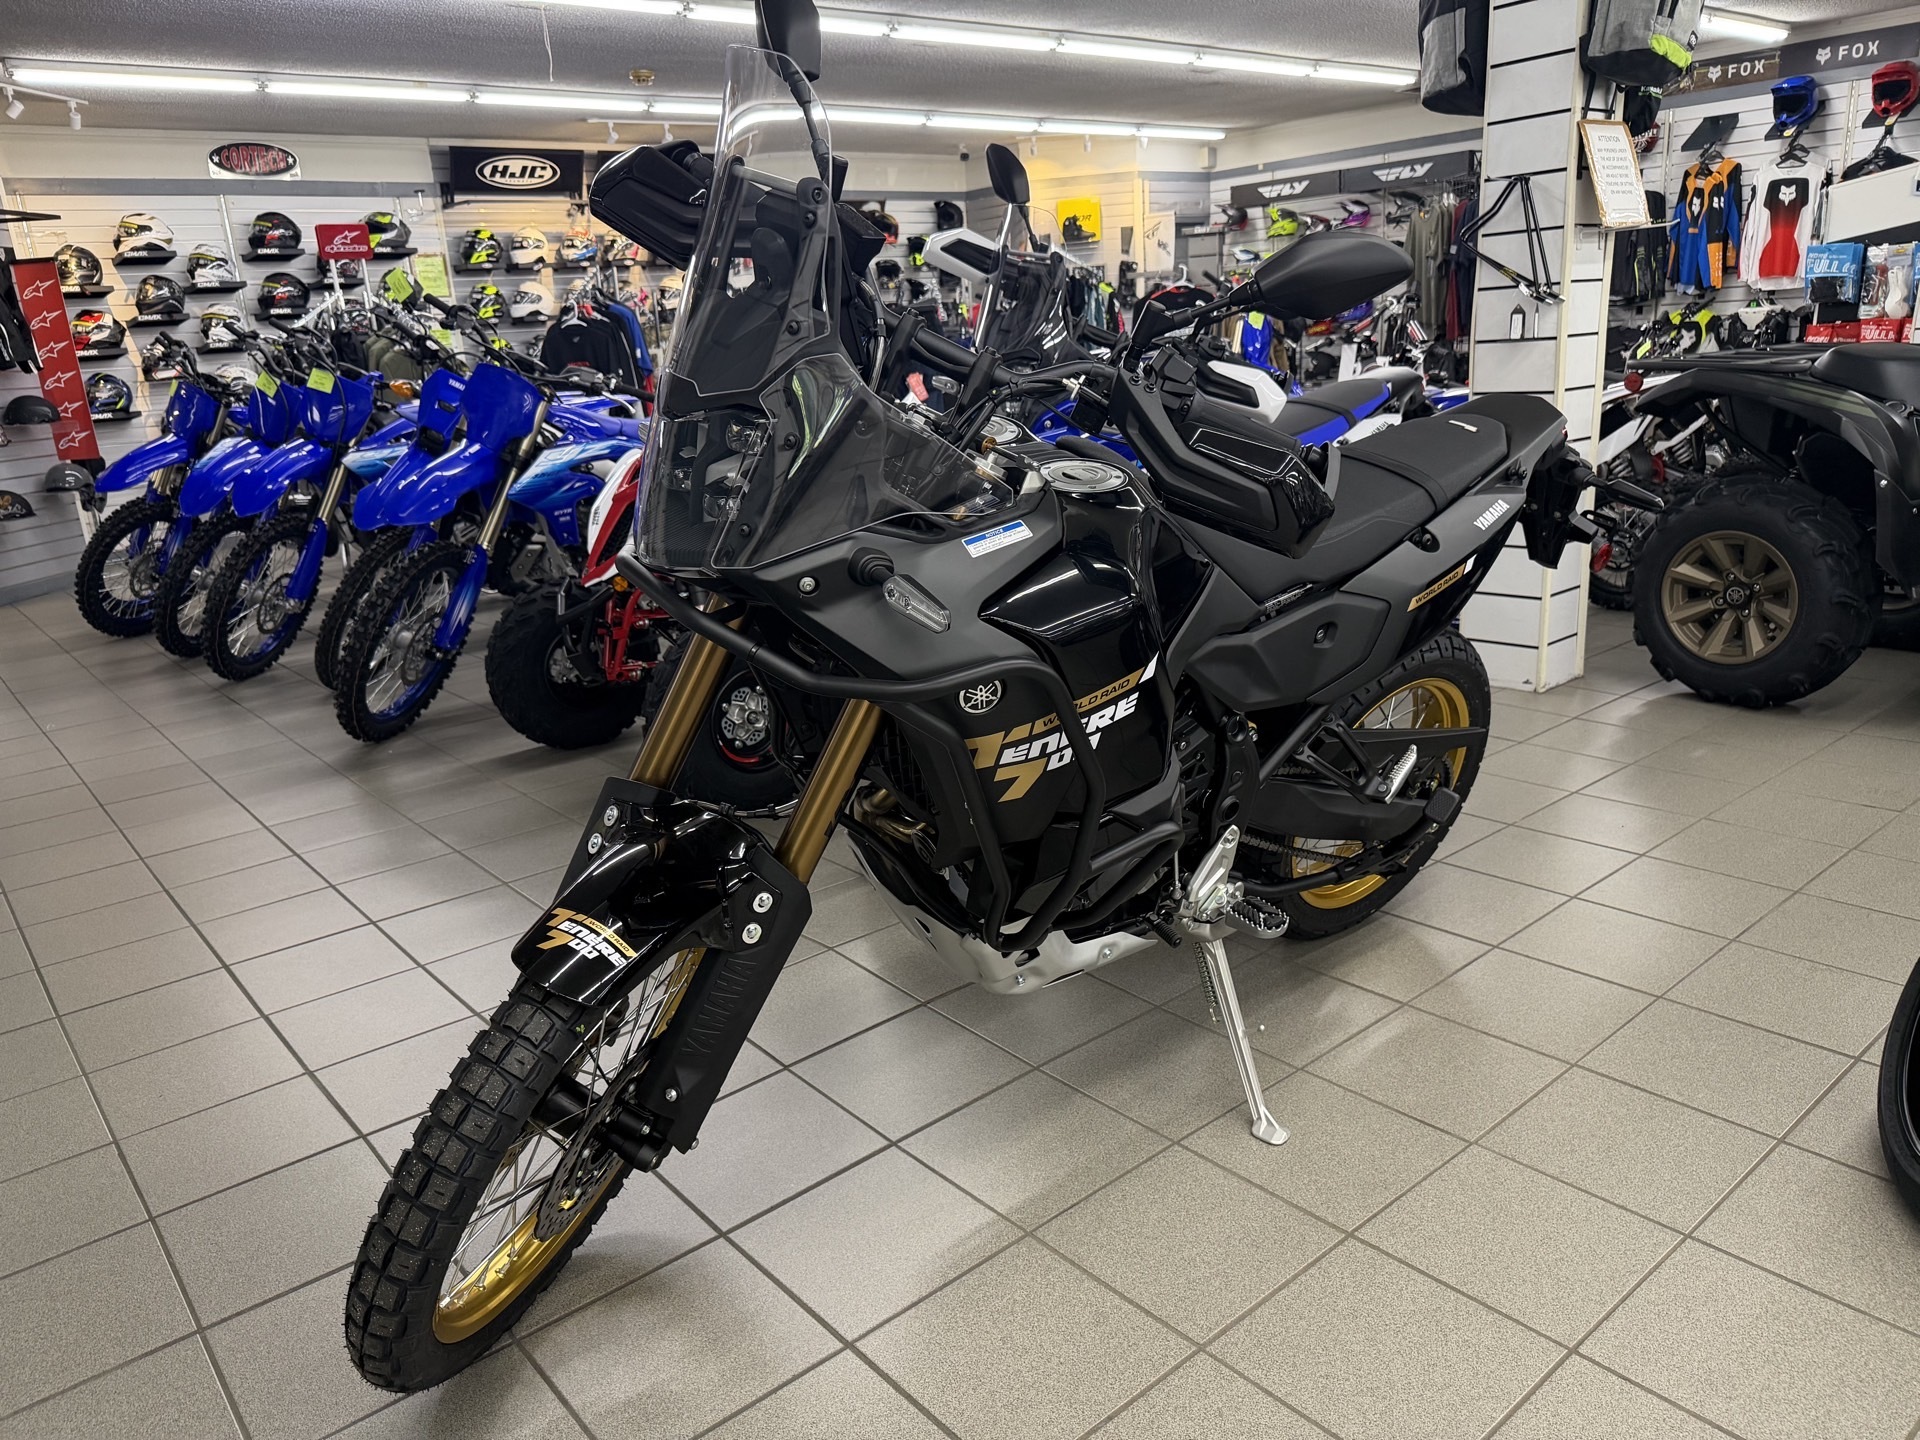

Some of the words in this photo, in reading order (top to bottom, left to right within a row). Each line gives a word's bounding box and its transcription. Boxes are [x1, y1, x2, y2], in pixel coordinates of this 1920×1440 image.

[1838, 40, 1880, 61] FOX
[1727, 59, 1766, 78] FOX
[220, 145, 287, 173] CORTECH
[489, 164, 547, 179] HJC
[1372, 162, 1434, 182] FLY
[1257, 180, 1310, 199] FLY
[1473, 499, 1510, 531] YAMAHA
[985, 528, 1005, 538] NOTICE
[1416, 583, 1443, 604] WORLD
[1443, 571, 1459, 587] RAID
[1100, 678, 1131, 700] RAID
[536, 929, 600, 960] 700
[614, 938, 630, 952] RAID
[680, 957, 758, 1054] YAMAHA
